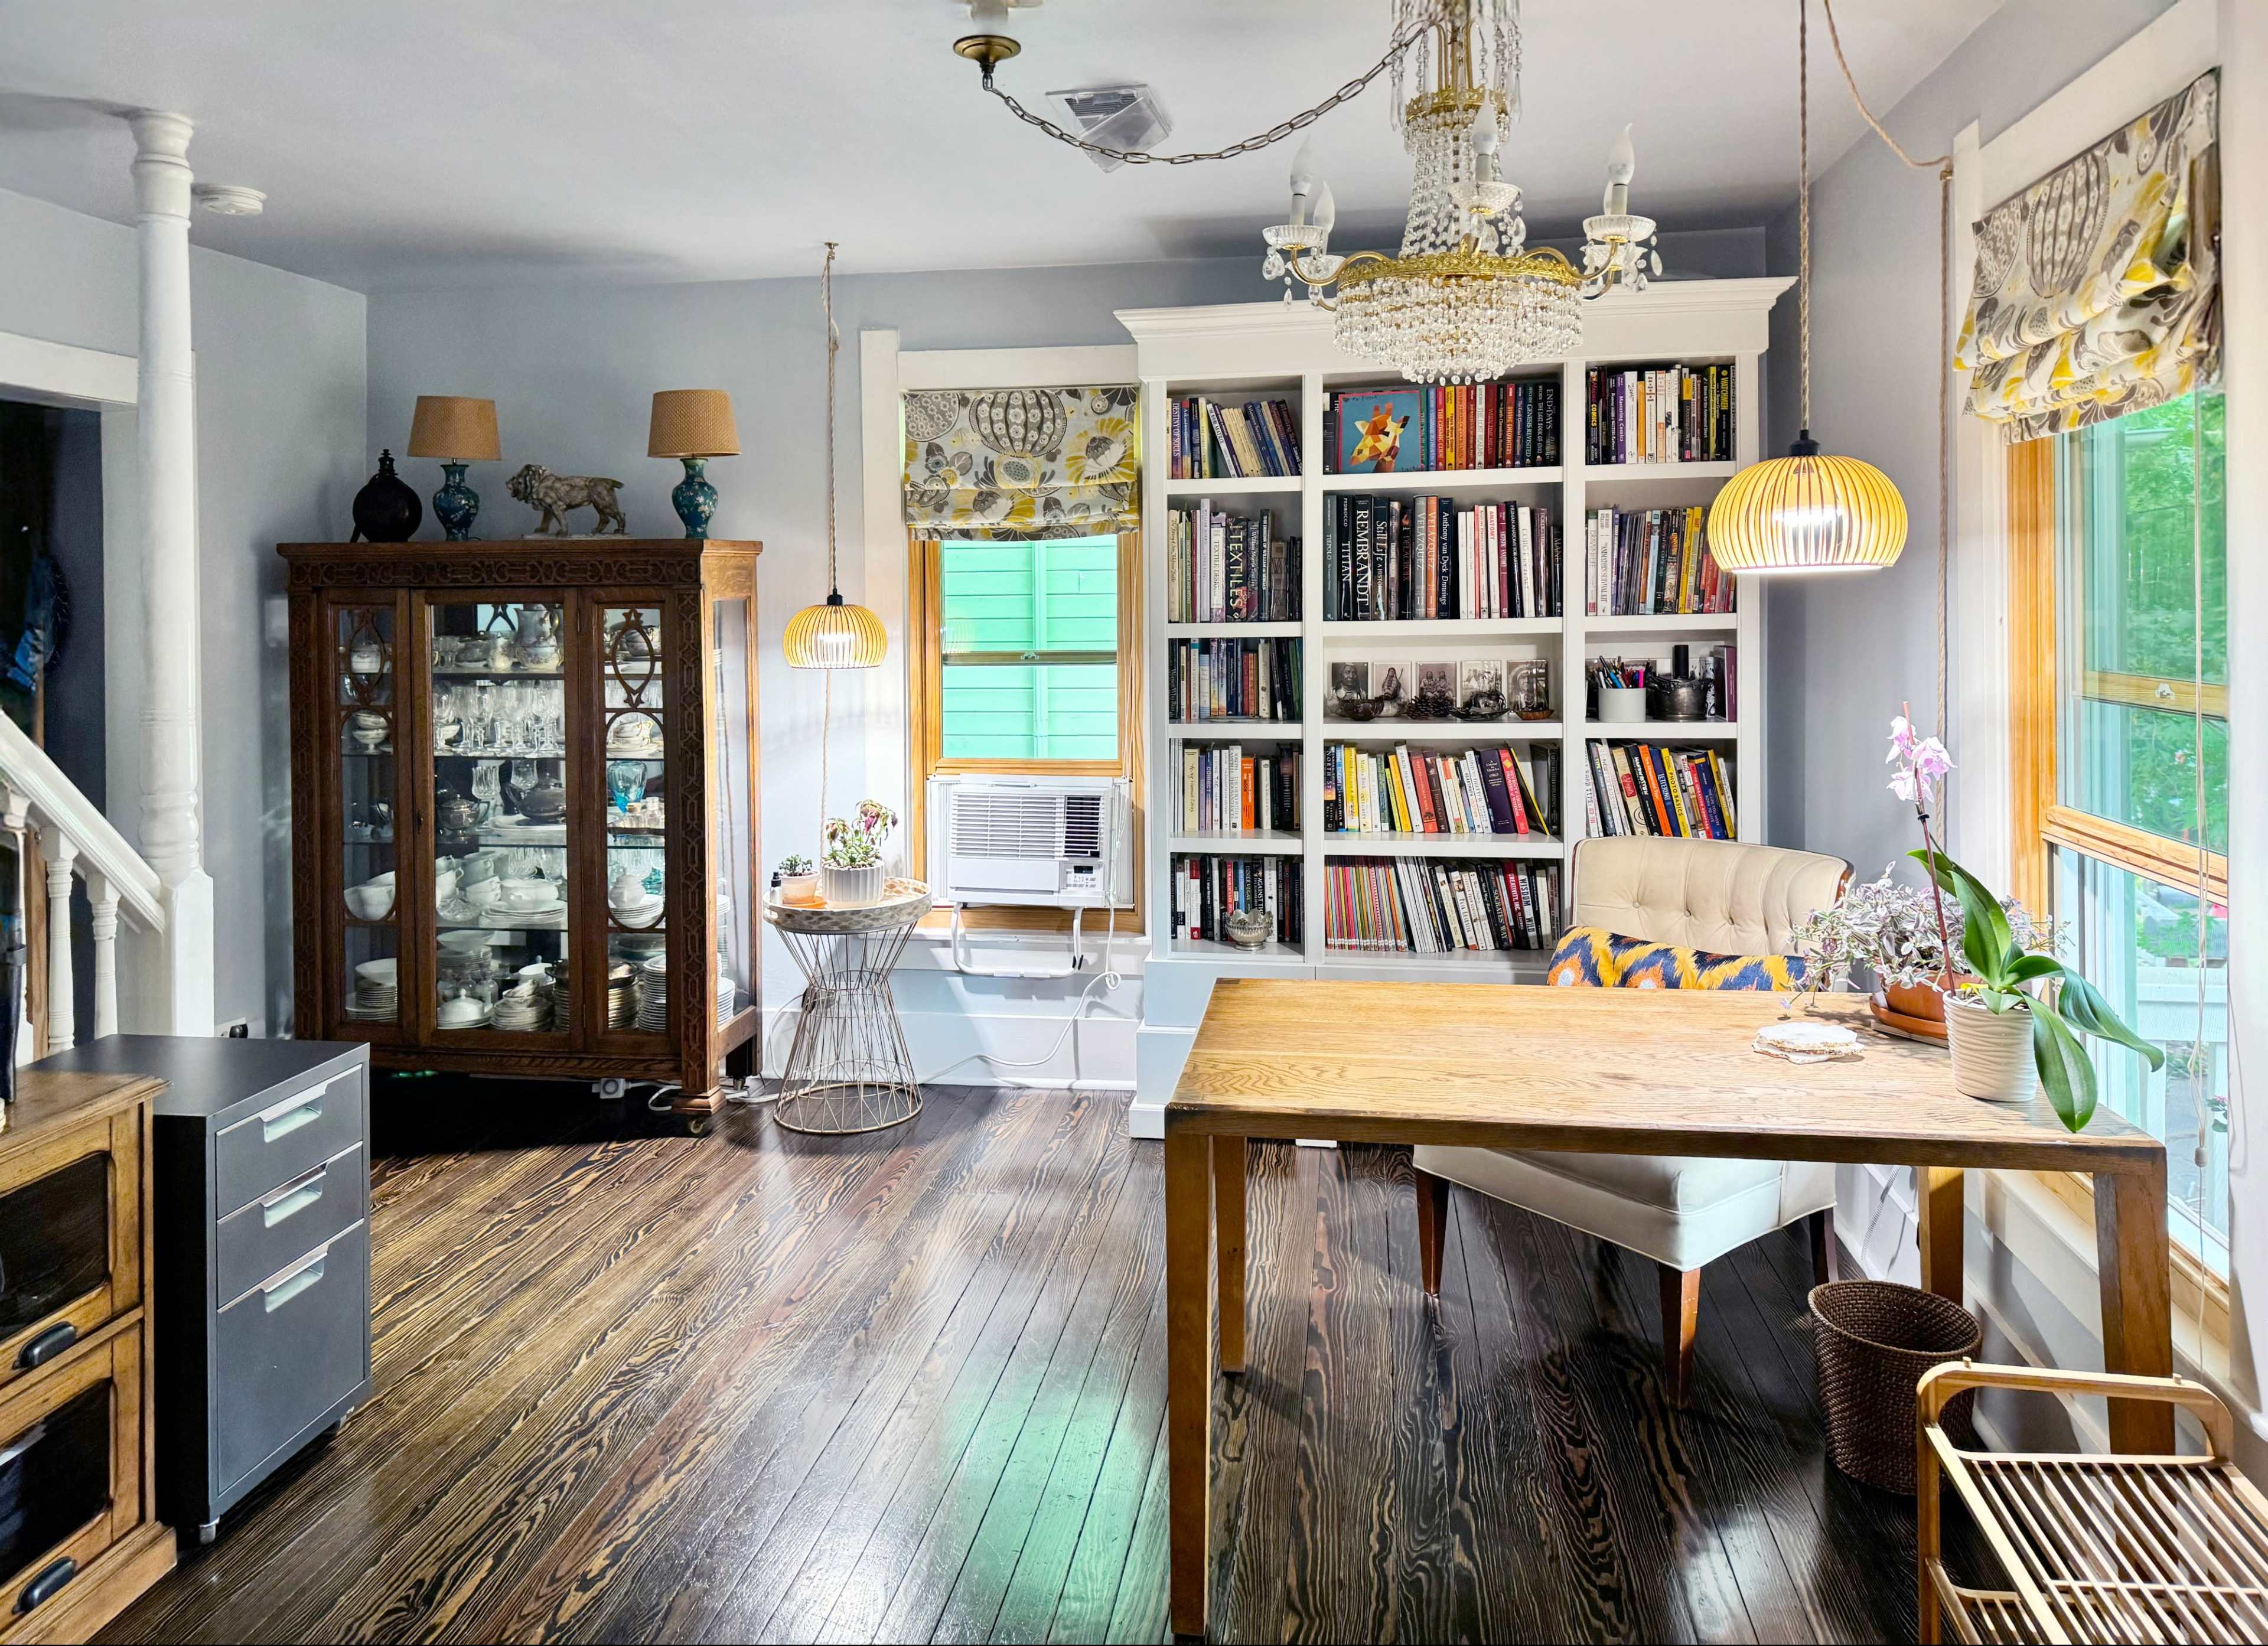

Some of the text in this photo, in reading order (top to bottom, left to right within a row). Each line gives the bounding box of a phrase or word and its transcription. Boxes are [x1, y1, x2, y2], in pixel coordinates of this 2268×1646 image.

[1720, 377, 1729, 410] WATCHMEN
[1214, 426, 1224, 444] MATRIX
[1376, 521, 1387, 539] Still
[1440, 511, 1449, 540] Anthony
[1342, 541, 1351, 582] TITIAN
[1356, 510, 1369, 606] REMBRANDT
[1373, 542, 1387, 562] Life
[1230, 532, 1243, 607] TEXTILES
[1439, 575, 1448, 605] Drawings
[1634, 757, 1648, 796] HANDWRITTEN
[1658, 773, 1670, 800] LETTERING
[1674, 795, 1683, 816] BASICS
[1520, 878, 1535, 932] WISDOM WILD
[1500, 924, 1508, 939] WAY
